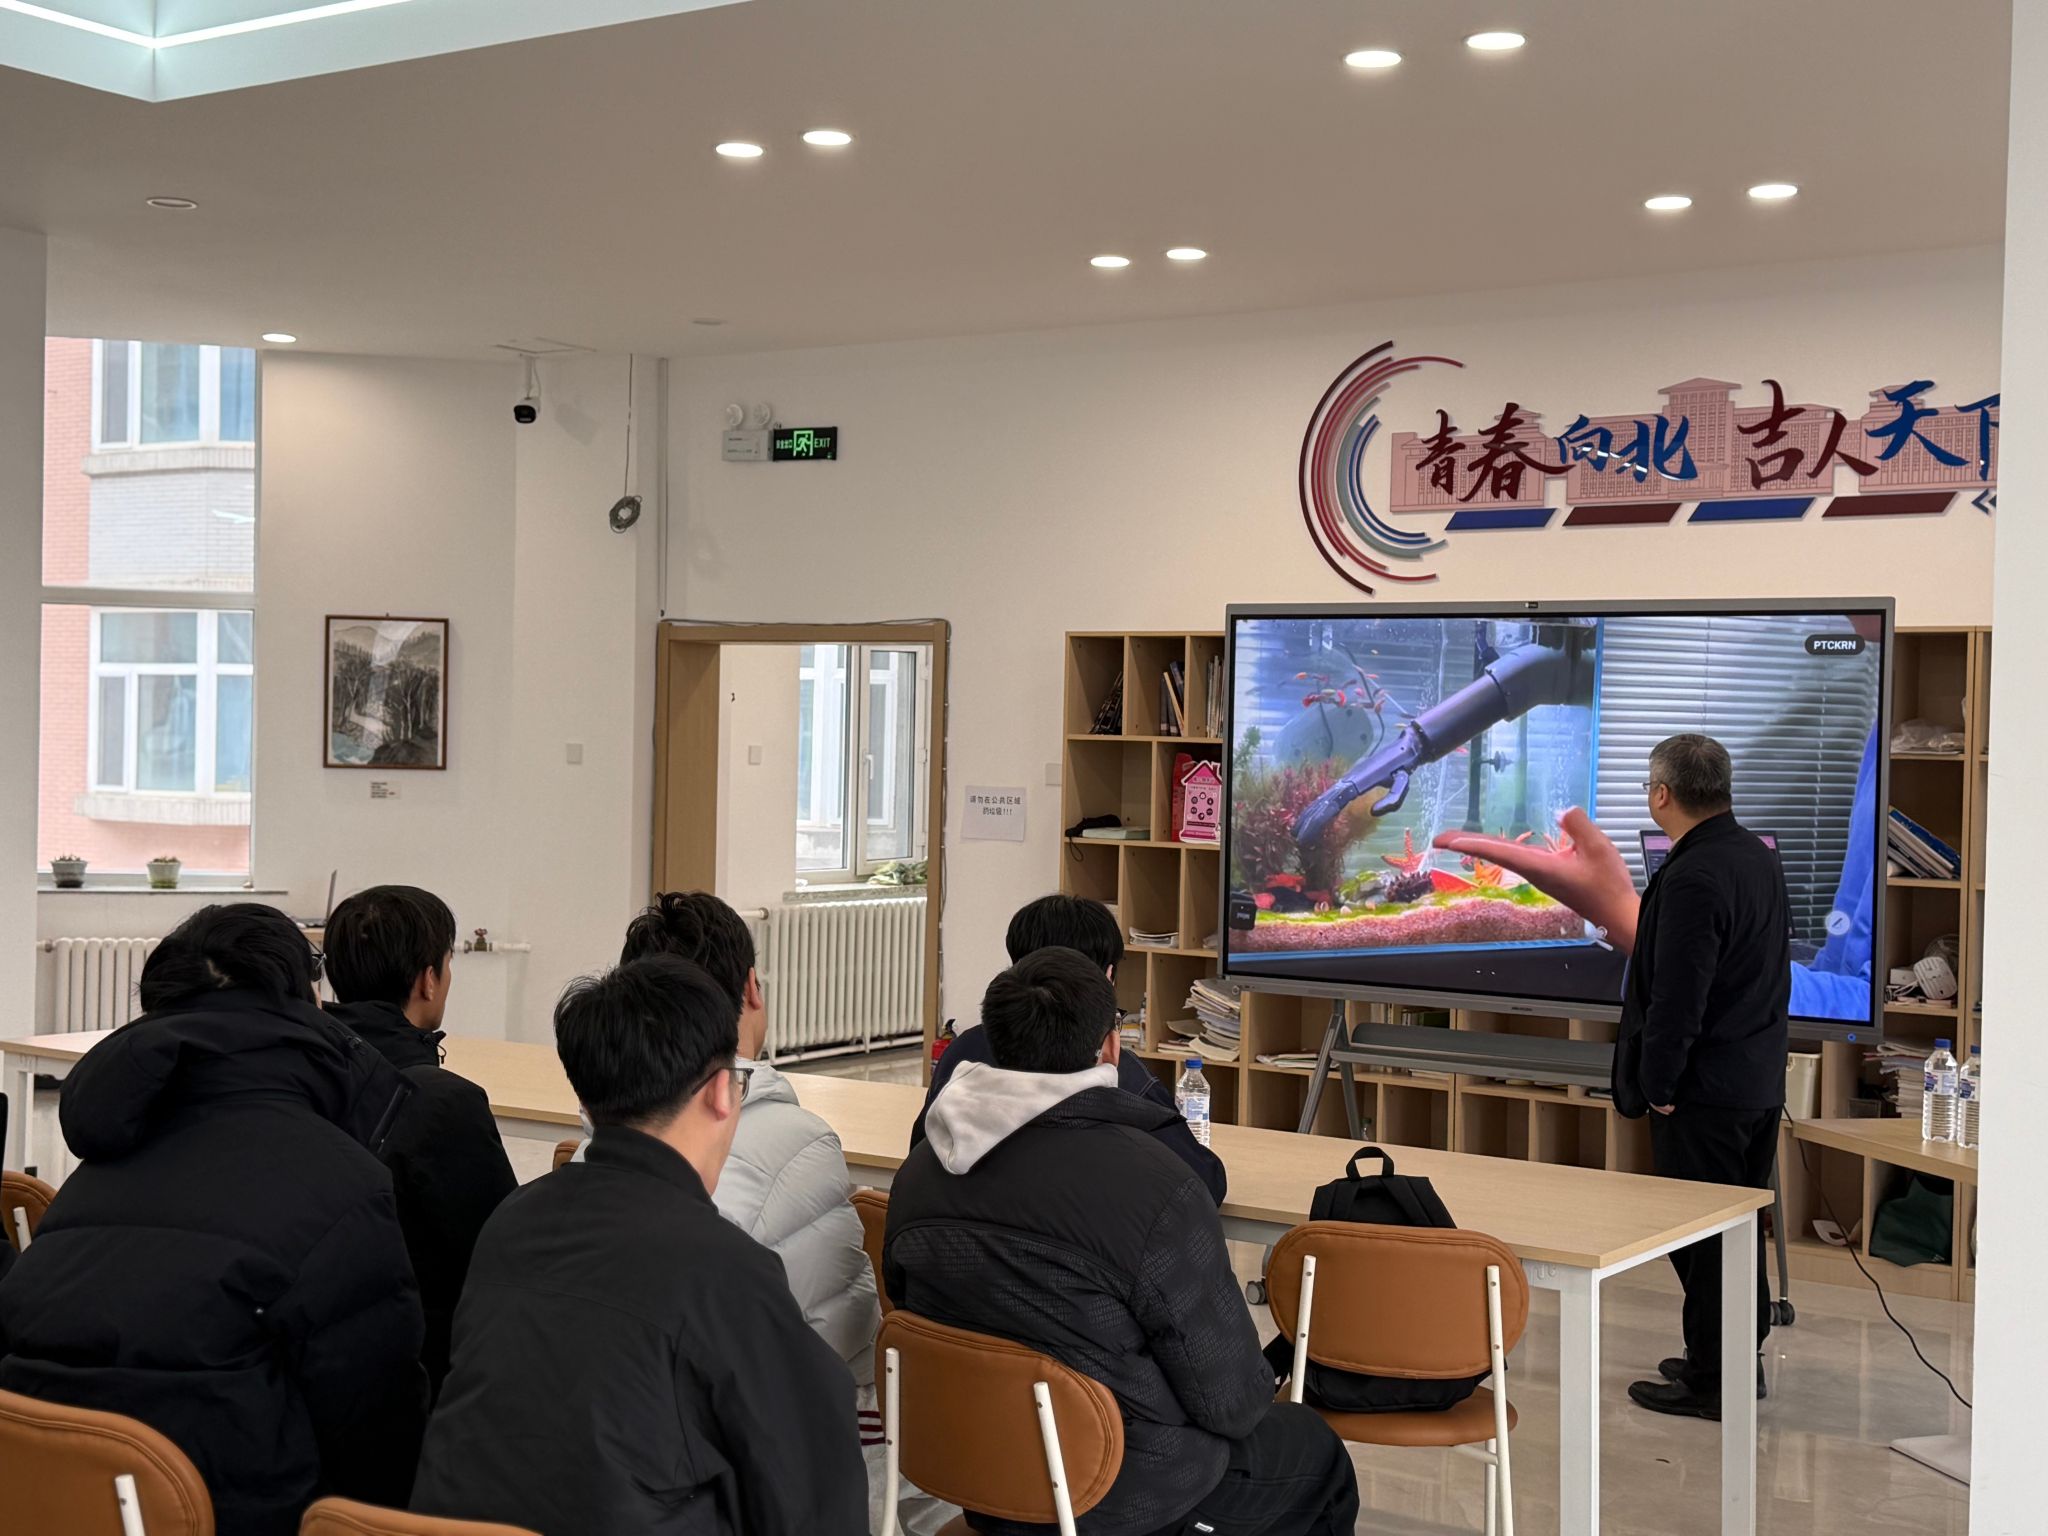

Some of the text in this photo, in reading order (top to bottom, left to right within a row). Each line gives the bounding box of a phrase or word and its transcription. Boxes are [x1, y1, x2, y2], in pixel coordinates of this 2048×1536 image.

[814, 437, 831, 448] EXIT
[1415, 402, 1698, 502] 青春向北
[1813, 640, 1857, 650] PTCKRN
